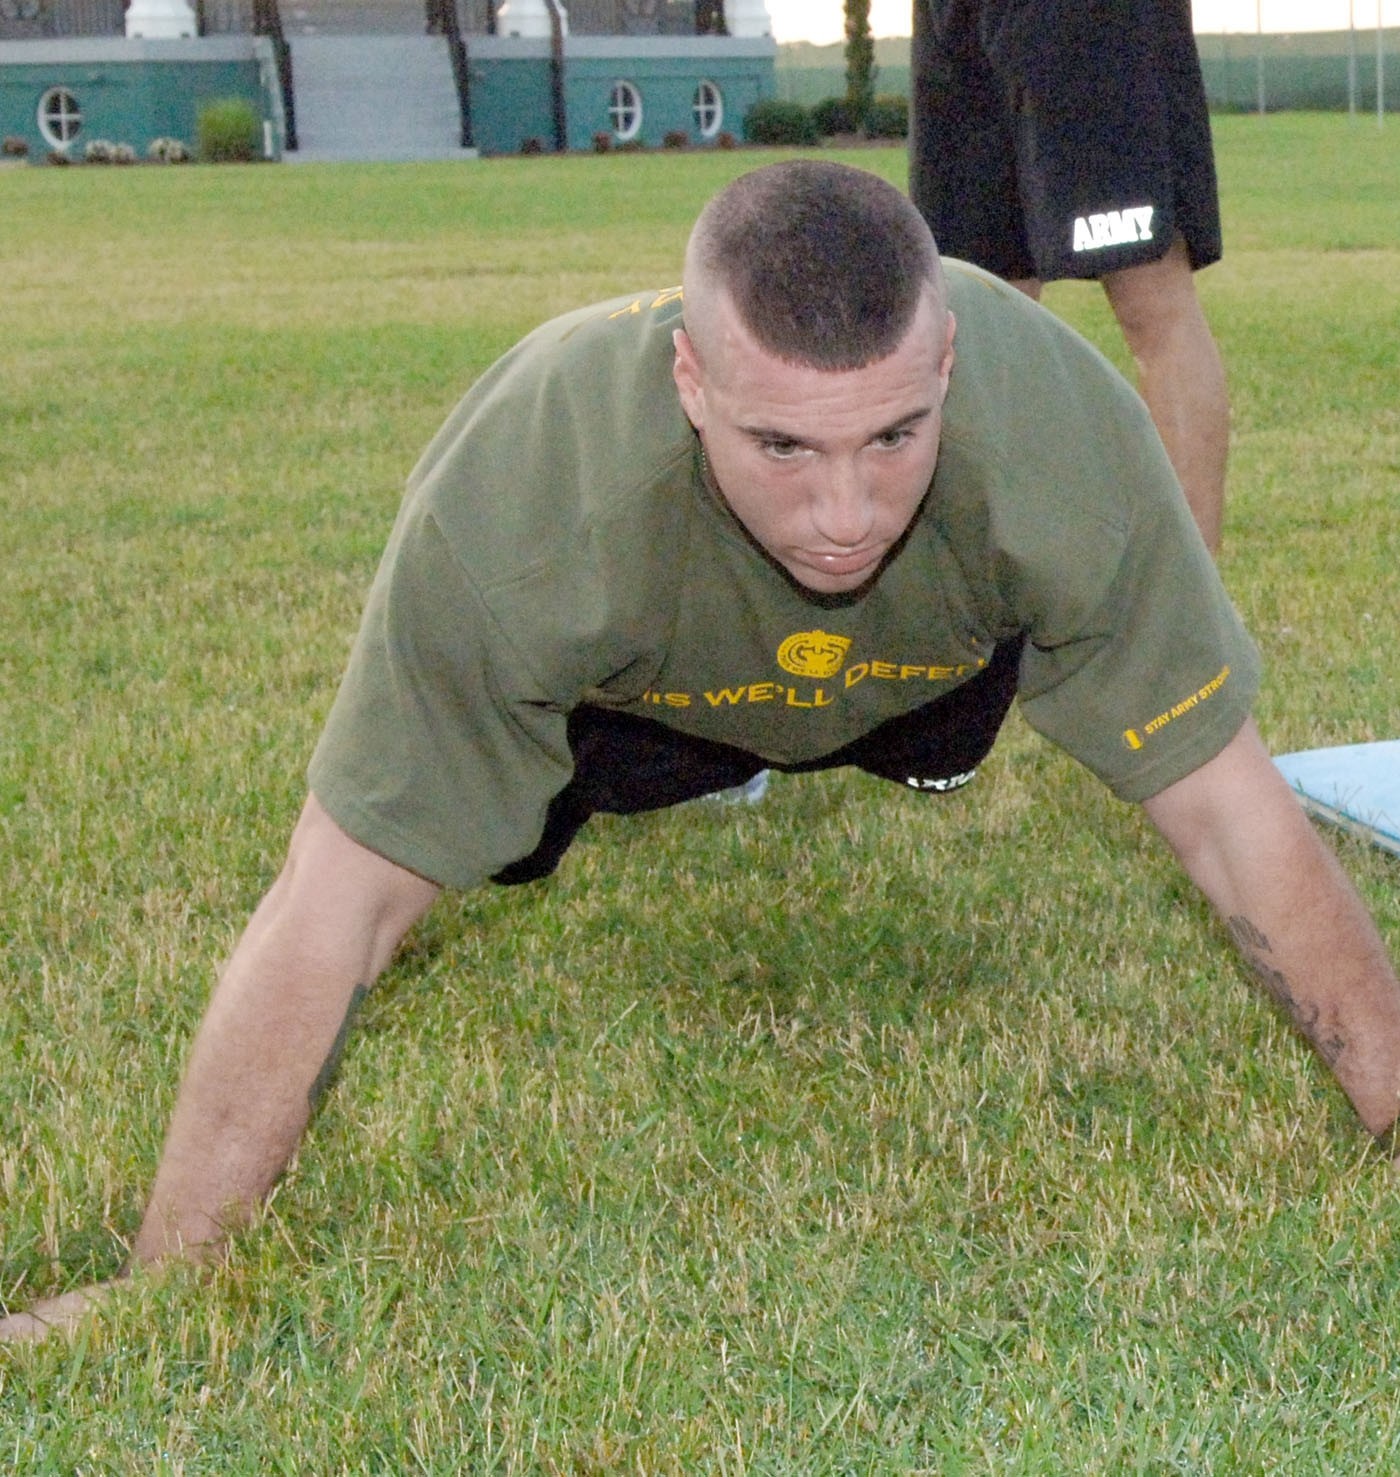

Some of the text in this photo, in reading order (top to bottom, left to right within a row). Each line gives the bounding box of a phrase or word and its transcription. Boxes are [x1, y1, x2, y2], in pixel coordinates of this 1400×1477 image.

[1073, 206, 1153, 252] ARMY
[704, 681, 834, 708] WE'LL
[1144, 712, 1170, 734] STAY
[1169, 694, 1199, 719] ARMY
